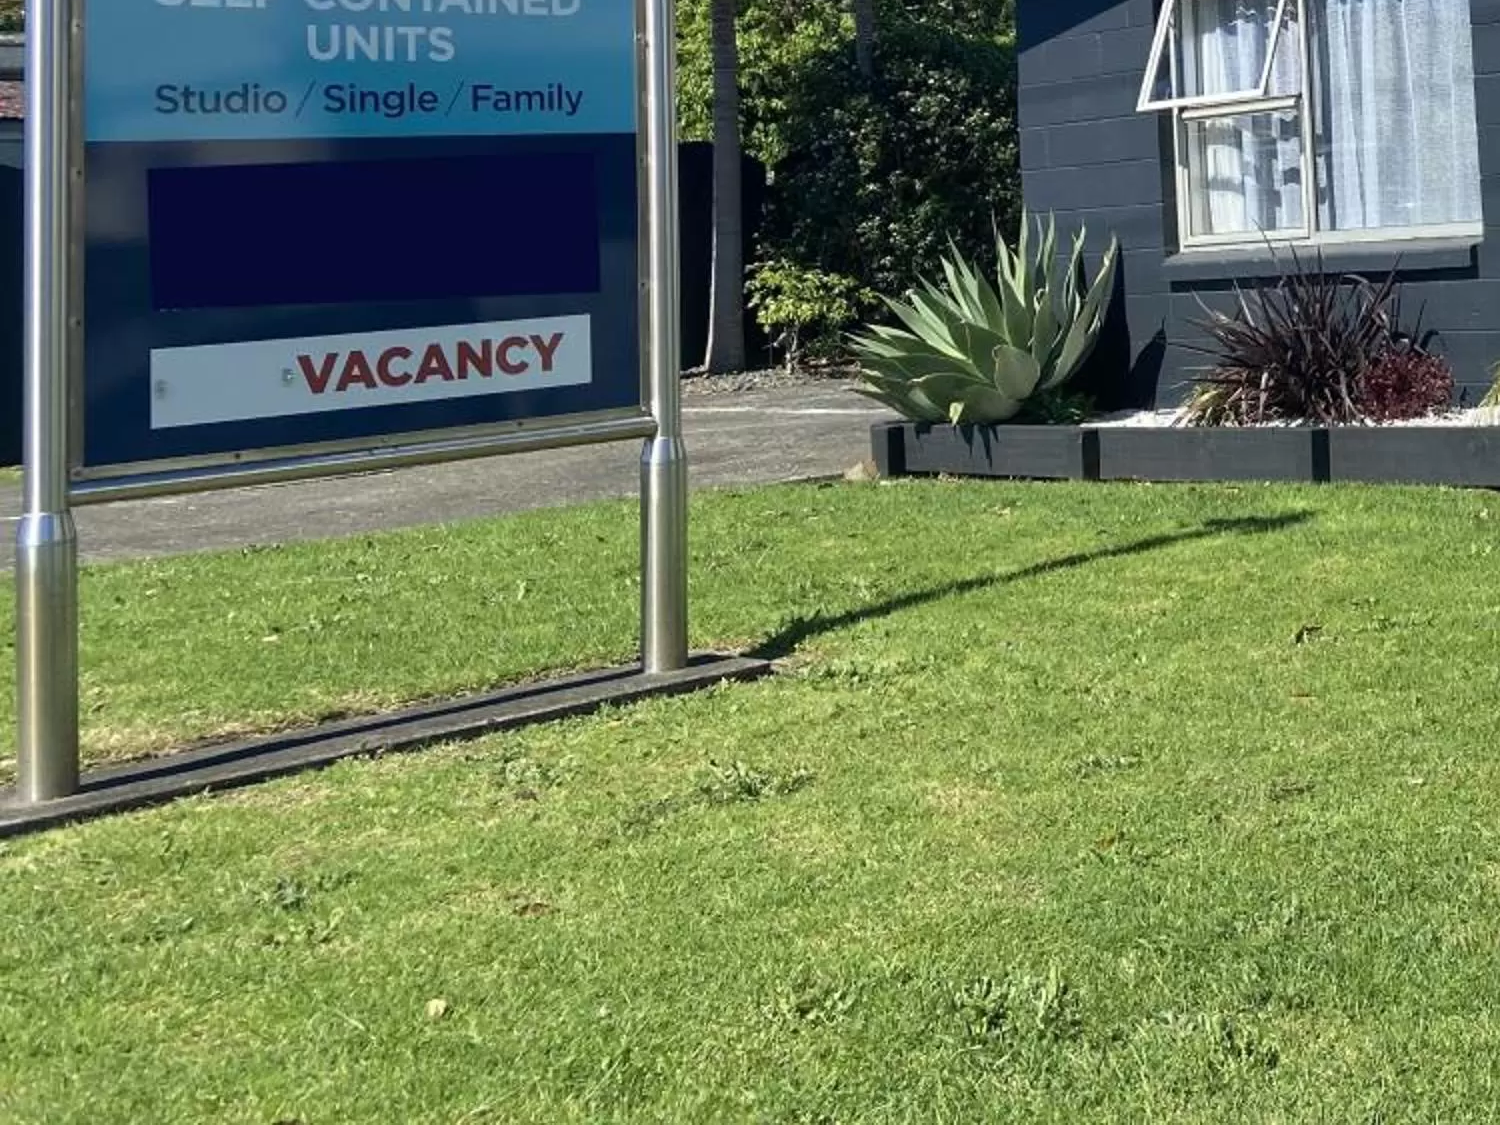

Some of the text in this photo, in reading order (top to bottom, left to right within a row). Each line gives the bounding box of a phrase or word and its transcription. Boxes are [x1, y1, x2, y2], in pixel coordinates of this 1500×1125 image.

[306, 24, 456, 63] UNITS
[154, 82, 288, 116] Studio
[322, 83, 439, 118] Single
[470, 82, 584, 117] Family
[297, 332, 565, 395] VACANCY
